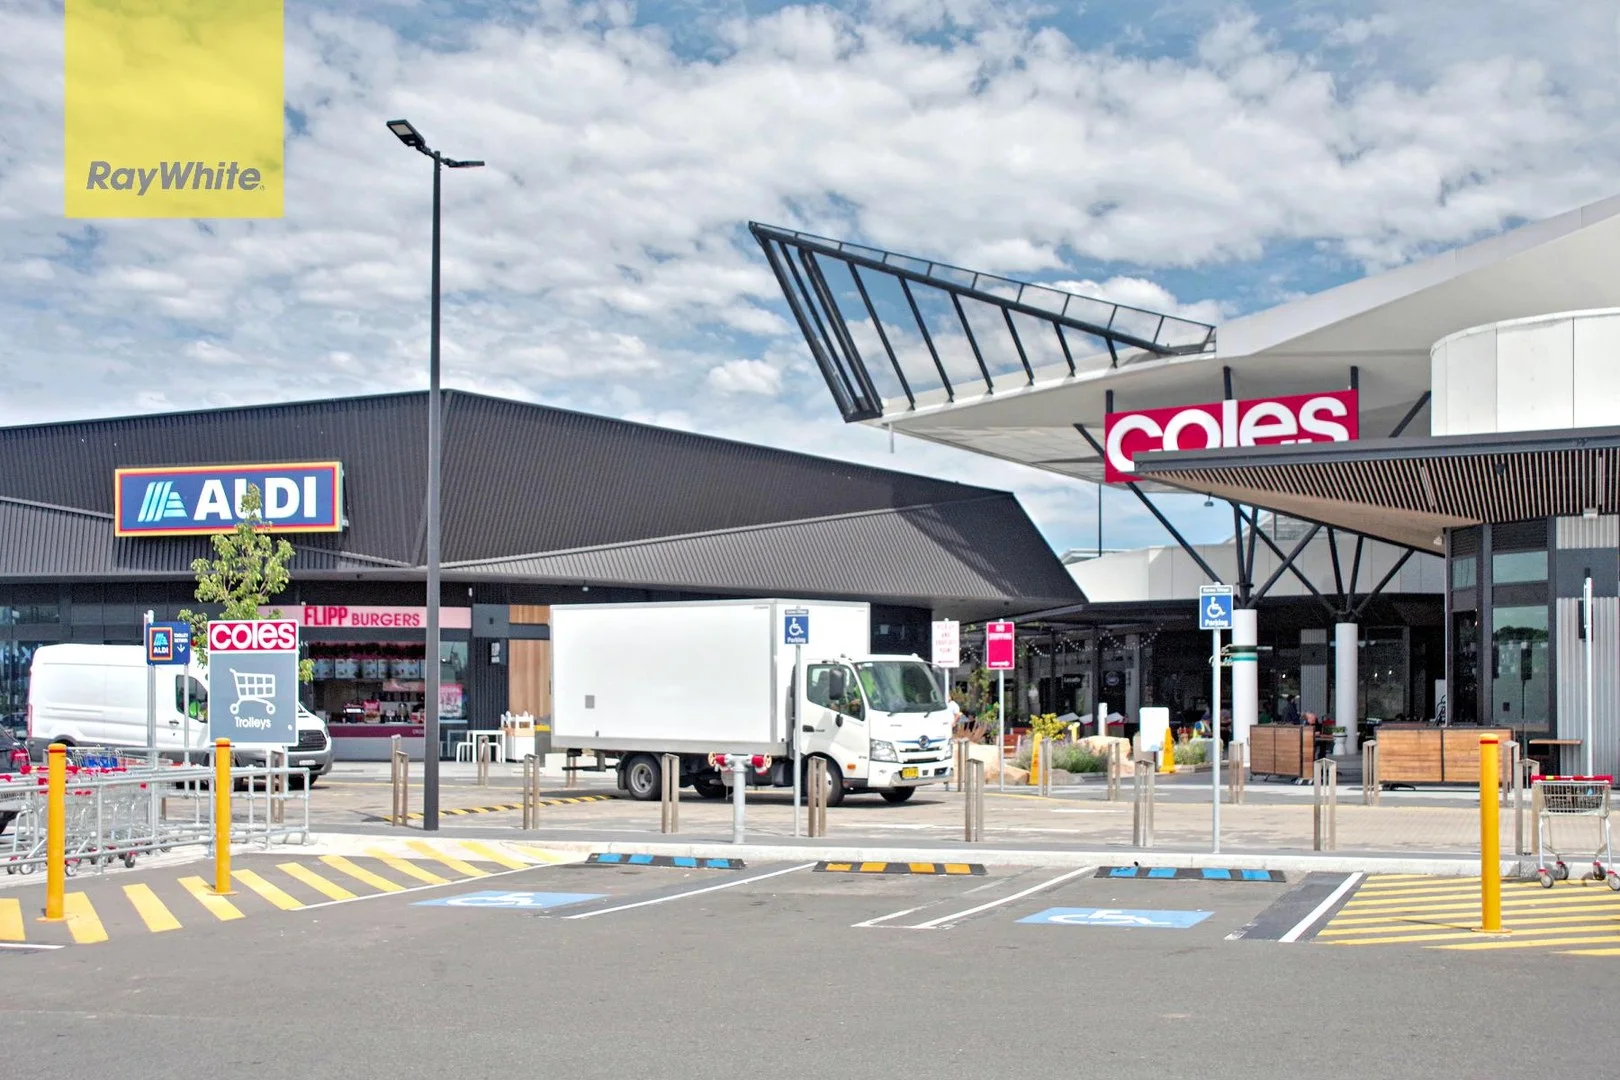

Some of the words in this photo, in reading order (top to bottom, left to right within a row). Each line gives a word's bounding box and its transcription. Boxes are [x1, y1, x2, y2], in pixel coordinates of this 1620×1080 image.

[1106, 396, 1350, 473] coles
[193, 476, 317, 521] ALDI
[304, 605, 348, 626] FLIPP
[351, 613, 420, 627] BURGERS
[1204, 619, 1229, 627] Parking
[211, 622, 295, 650] coles
[234, 716, 272, 730] Trolleys
